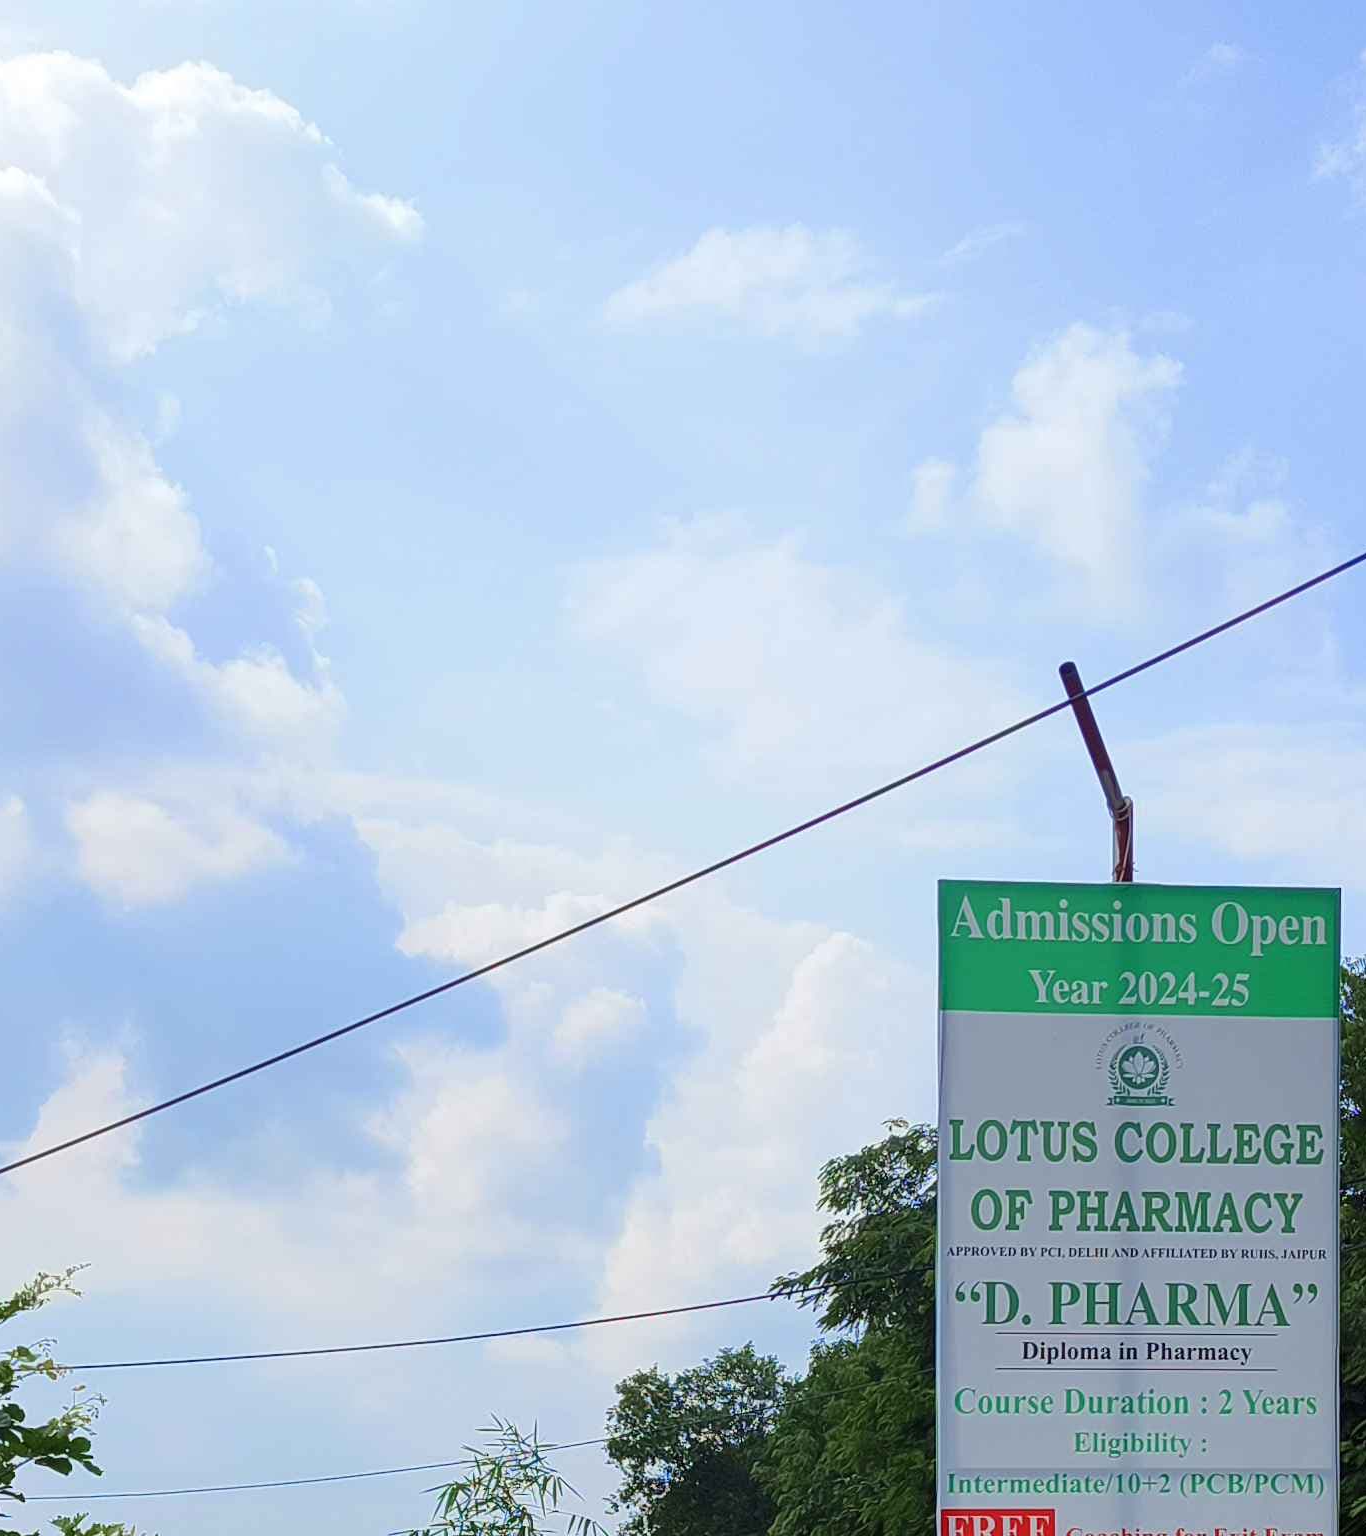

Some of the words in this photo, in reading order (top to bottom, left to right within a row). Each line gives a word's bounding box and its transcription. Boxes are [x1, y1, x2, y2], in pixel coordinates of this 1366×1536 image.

[951, 895, 1197, 944] Admissions
[1212, 900, 1327, 957] Open
[1029, 969, 1108, 1005] Year
[1118, 971, 1251, 1008] 2024-25
[949, 1119, 1098, 1163] LOTUS
[1114, 1121, 1325, 1165] COLLEGE
[971, 1188, 1033, 1232] OF
[1048, 1190, 1304, 1234] PHARMACY
[947, 1246, 1017, 1258] APPROVED
[1020, 1247, 1038, 1257] BY
[1040, 1247, 1066, 1259] PCI,
[1068, 1247, 1109, 1258] DELHI
[1110, 1248, 1139, 1258] AND
[1142, 1248, 1218, 1259] AFFILIATED
[1221, 1249, 1238, 1259] BY
[1281, 1249, 1327, 1260] JAIPUR
[955, 1281, 1032, 1326] “D.
[1048, 1281, 1319, 1327] PHARMA”
[1022, 1341, 1111, 1365] Diploma
[1119, 1342, 1138, 1360] in
[1147, 1342, 1252, 1366] Pharmacy
[955, 1387, 1054, 1414] Course
[1065, 1387, 1189, 1415] Duration
[1200, 1396, 1207, 1414] :
[1218, 1389, 1234, 1415] 2
[1243, 1389, 1317, 1415] Years
[1074, 1432, 1191, 1458] Eligibility
[947, 1473, 1171, 1494] Intermediate/10+2
[1180, 1473, 1324, 1498] (PCB/PCM)
